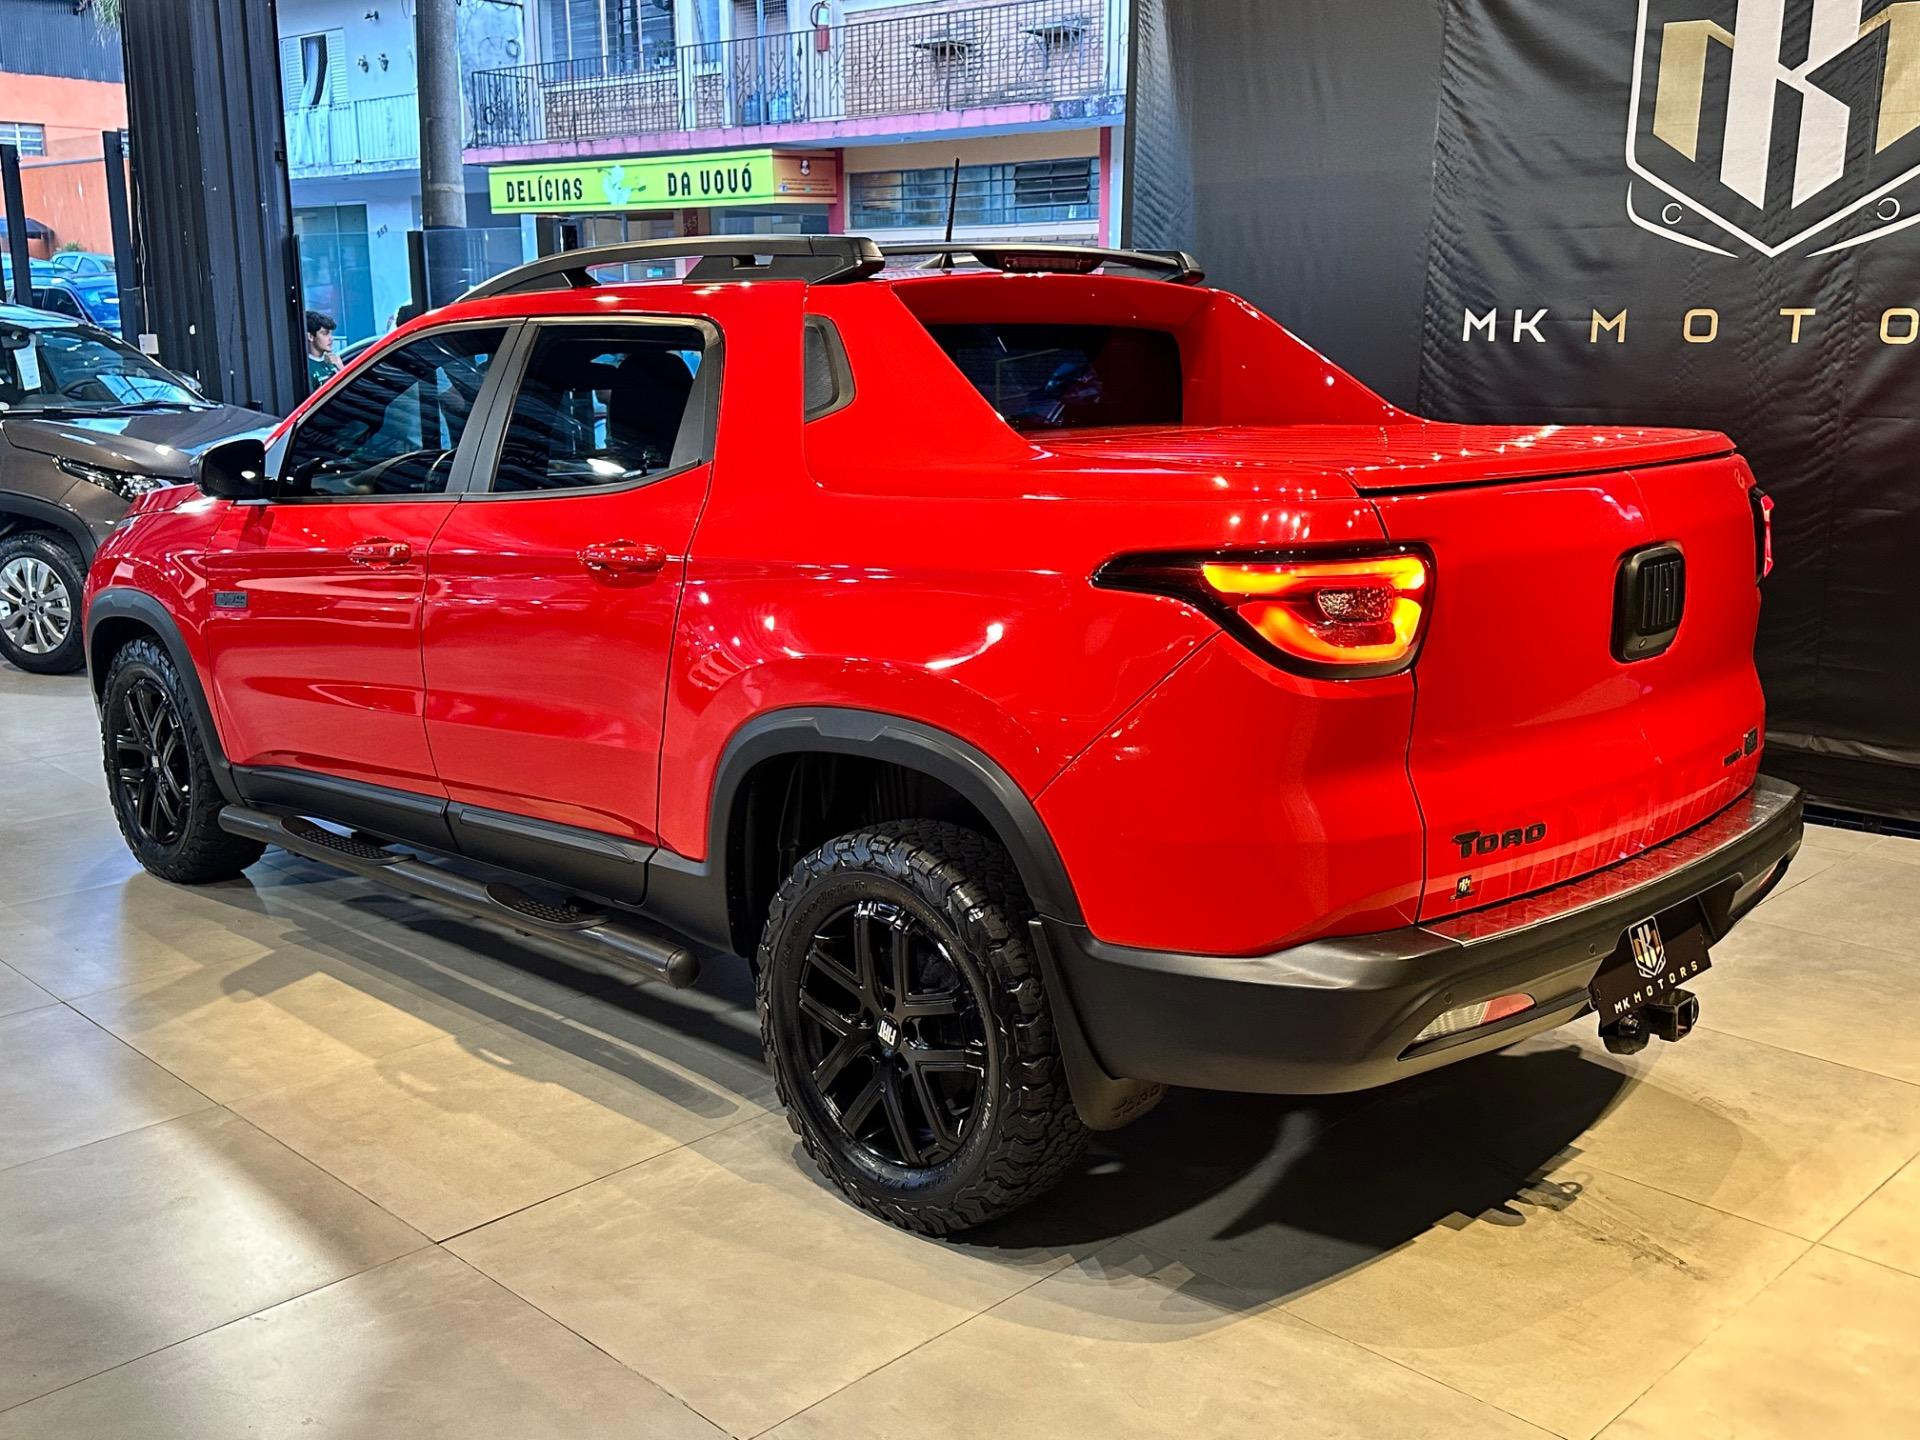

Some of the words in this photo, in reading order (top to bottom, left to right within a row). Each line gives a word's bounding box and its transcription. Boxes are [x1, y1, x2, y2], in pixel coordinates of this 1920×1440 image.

[506, 175, 583, 203] DELÍCIAS
[667, 171, 691, 197] DA
[1462, 307, 1548, 343] MK
[1452, 822, 1547, 859] TORO
[1614, 997, 1631, 1014] MK
[1633, 960, 1698, 1004] MOTORS
